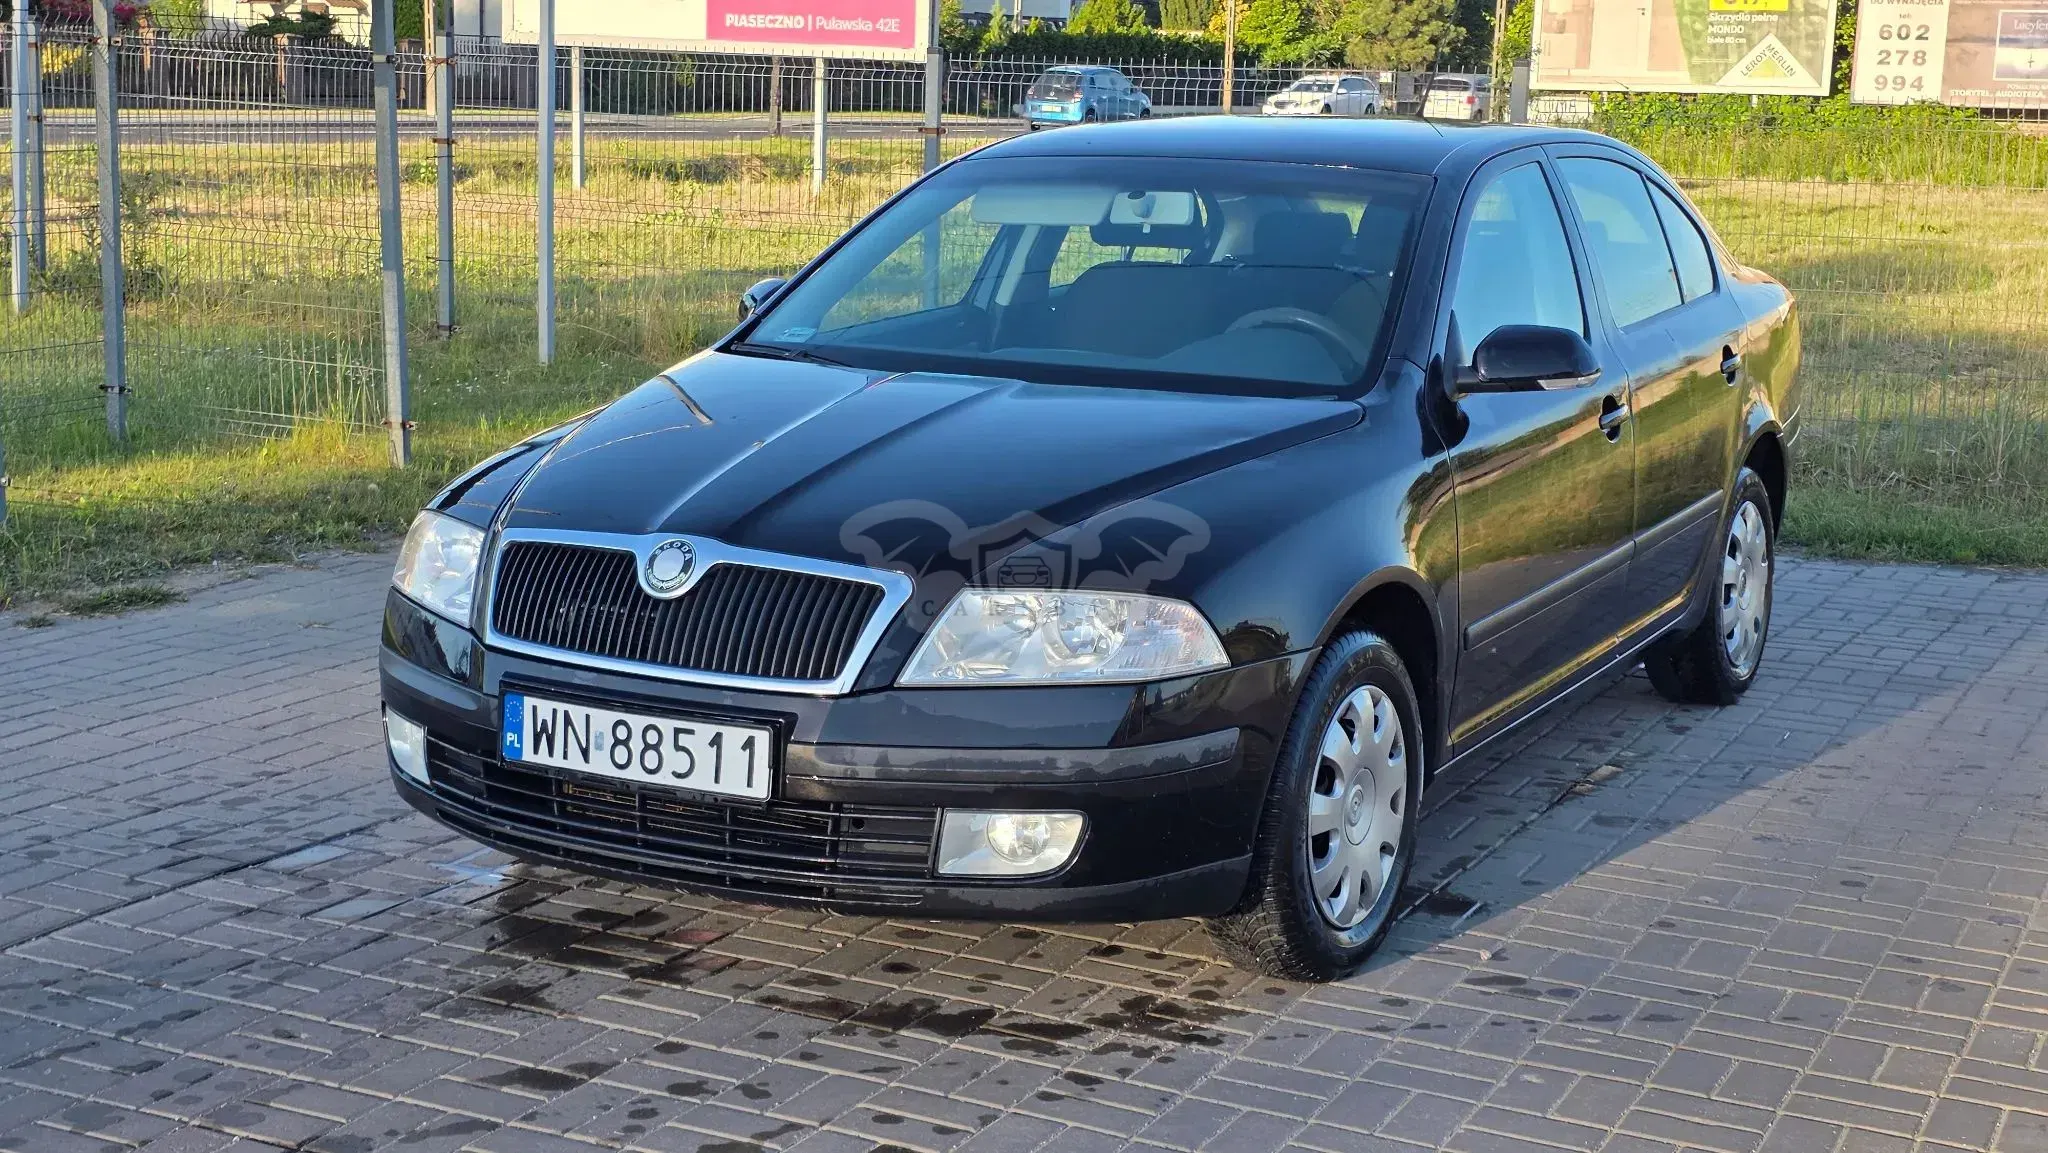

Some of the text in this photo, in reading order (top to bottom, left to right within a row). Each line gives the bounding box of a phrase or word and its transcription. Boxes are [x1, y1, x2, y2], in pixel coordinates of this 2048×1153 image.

[725, 13, 805, 29] PIASECZNO
[815, 15, 873, 32] Puławska
[875, 17, 901, 33] 42E
[1708, 24, 1745, 34] MONDO
[1878, 23, 1930, 41] 602
[1740, 43, 1797, 77] LEROY MERLIN
[1876, 49, 1927, 66] 278
[1874, 74, 1924, 92] 994
[506, 732, 521, 748] PL
[532, 704, 756, 789] WN 88511
